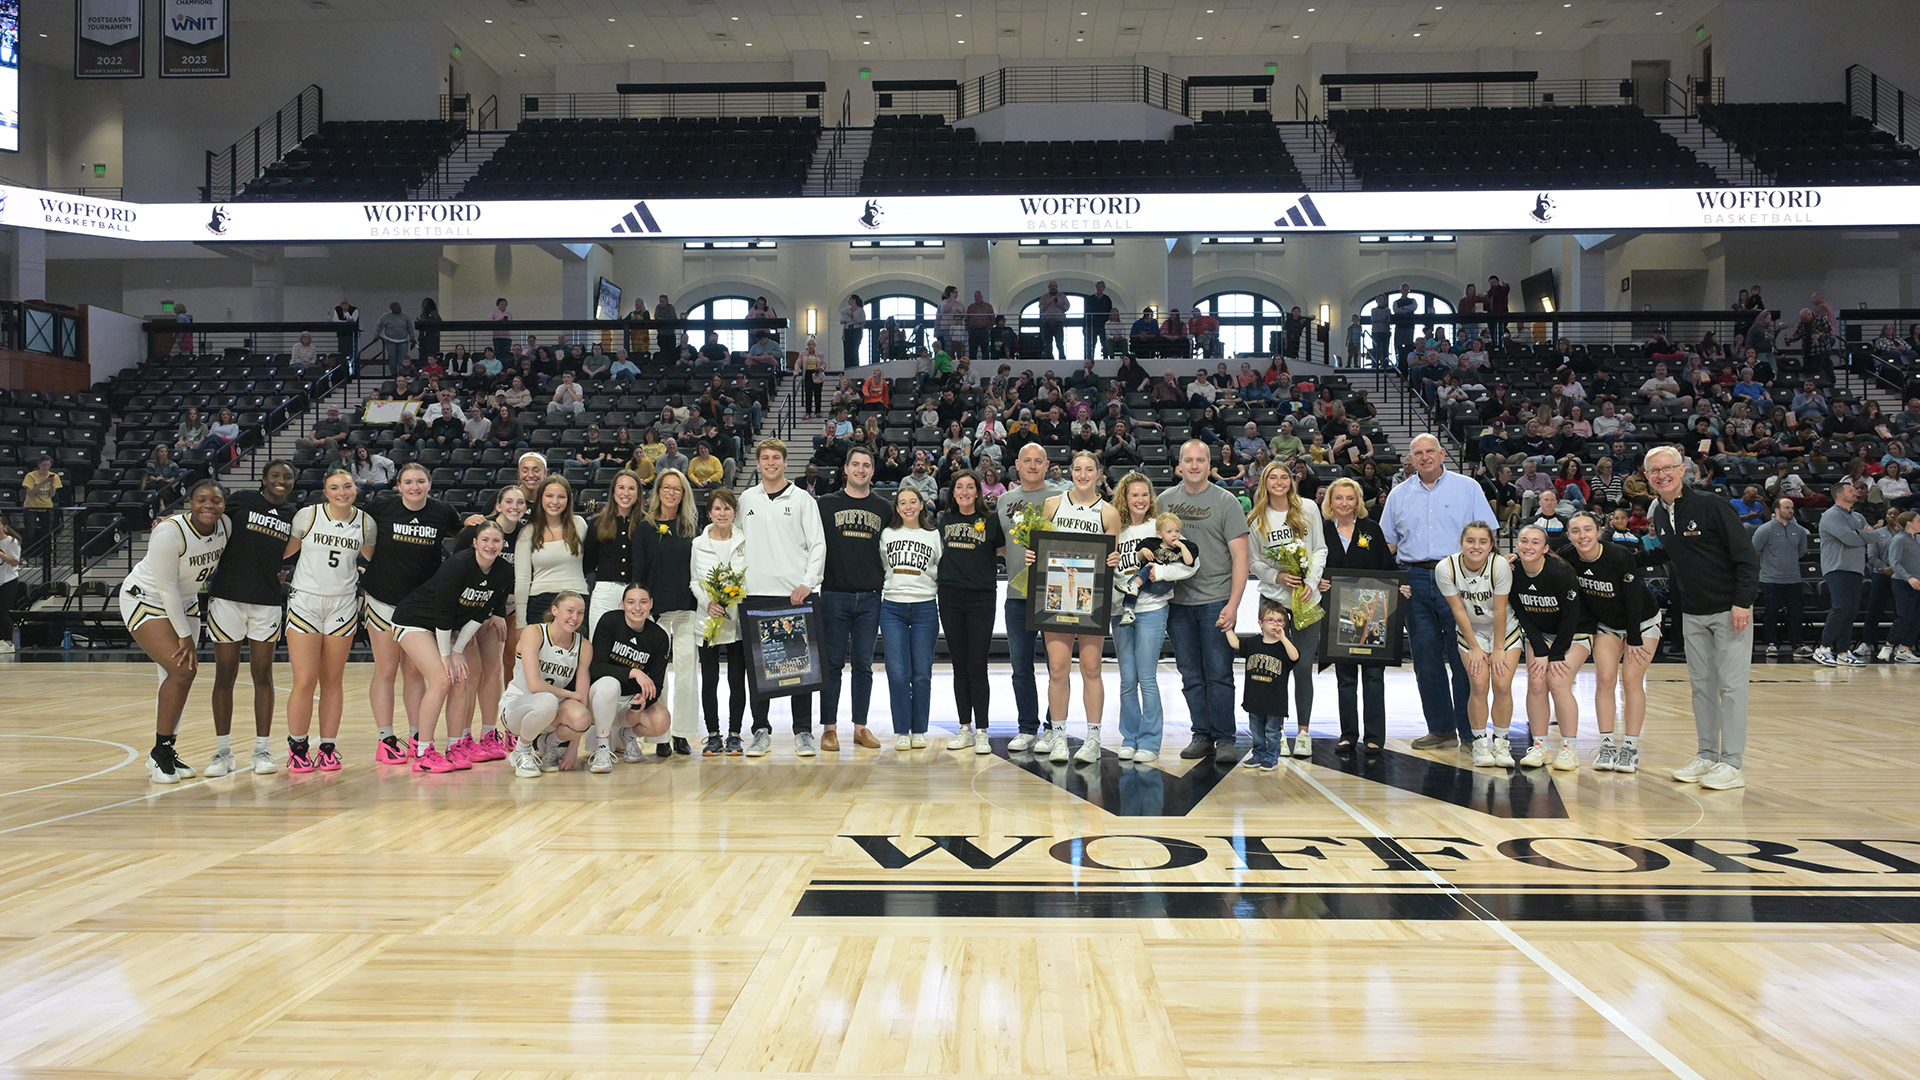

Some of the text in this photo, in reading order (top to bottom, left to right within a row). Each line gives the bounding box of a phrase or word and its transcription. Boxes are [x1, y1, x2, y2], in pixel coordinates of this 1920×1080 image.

[172, 16, 218, 31] WNIT
[97, 57, 123, 65] 2022
[181, 56, 208, 64] 2023
[1019, 197, 1141, 216] WOFFORD
[1695, 190, 1821, 209] WOFFORD
[39, 198, 137, 223] WOFFORD
[363, 204, 482, 222] WOFFORD
[1704, 213, 1813, 224] BASKETBALL
[45, 214, 131, 232] BASKETBALL
[371, 226, 474, 236] BASKETBALL
[1027, 219, 1133, 230] BASKETBALL
[1168, 502, 1211, 516] Wofford
[248, 511, 291, 535] WOFFORD
[834, 509, 882, 532] WOFFORD
[1057, 517, 1099, 534] WOFFORD
[393, 523, 438, 538] WOFFORD
[1266, 526, 1309, 542] TERRIS
[314, 533, 360, 551] WOFFORD
[886, 540, 933, 559] WOFFORD
[328, 550, 341, 568] 5
[888, 551, 929, 572] COLLEGE
[612, 640, 650, 664] WOFFORD
[1246, 653, 1282, 676] FFORD
